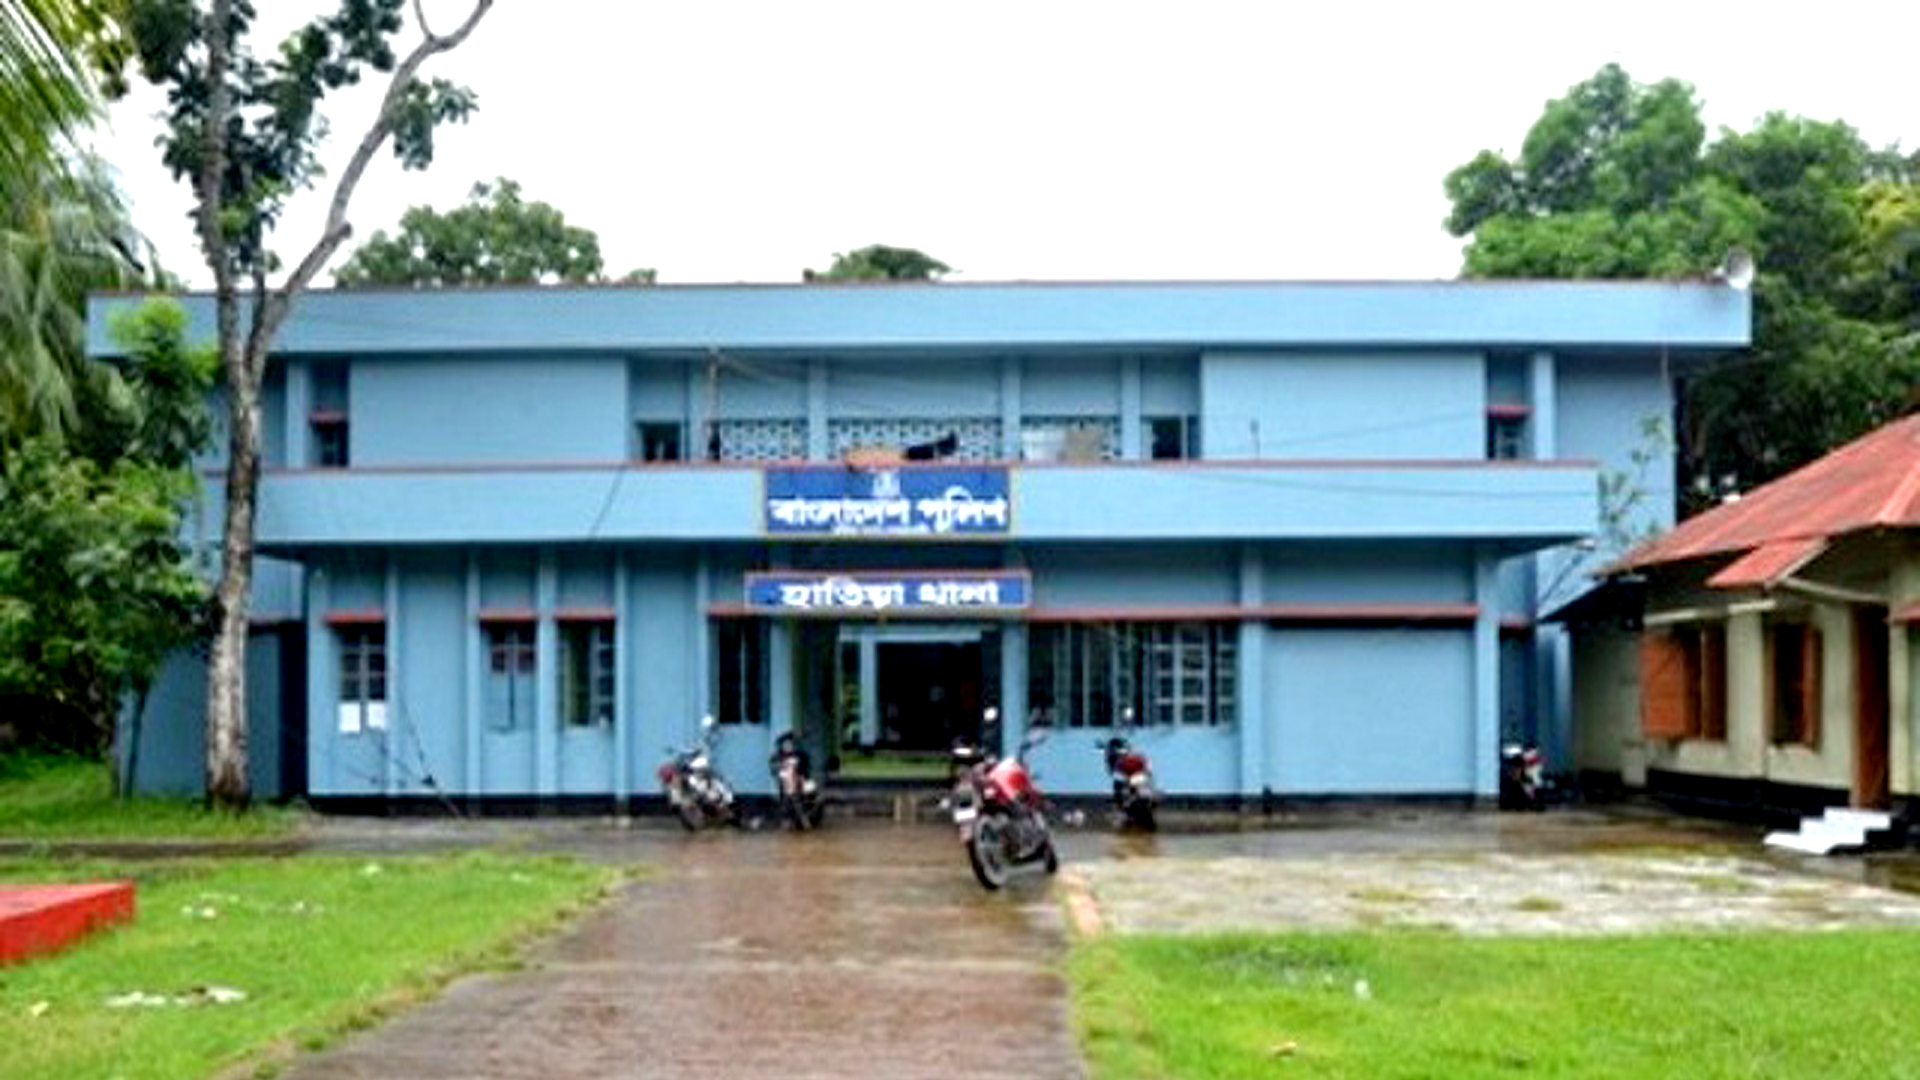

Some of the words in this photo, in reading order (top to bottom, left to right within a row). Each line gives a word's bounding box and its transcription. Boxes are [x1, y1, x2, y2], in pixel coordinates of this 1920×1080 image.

[769, 498, 910, 525] বাংলাদেশ
[917, 485, 1007, 532] পুলিশ
[918, 580, 999, 605] থানা
